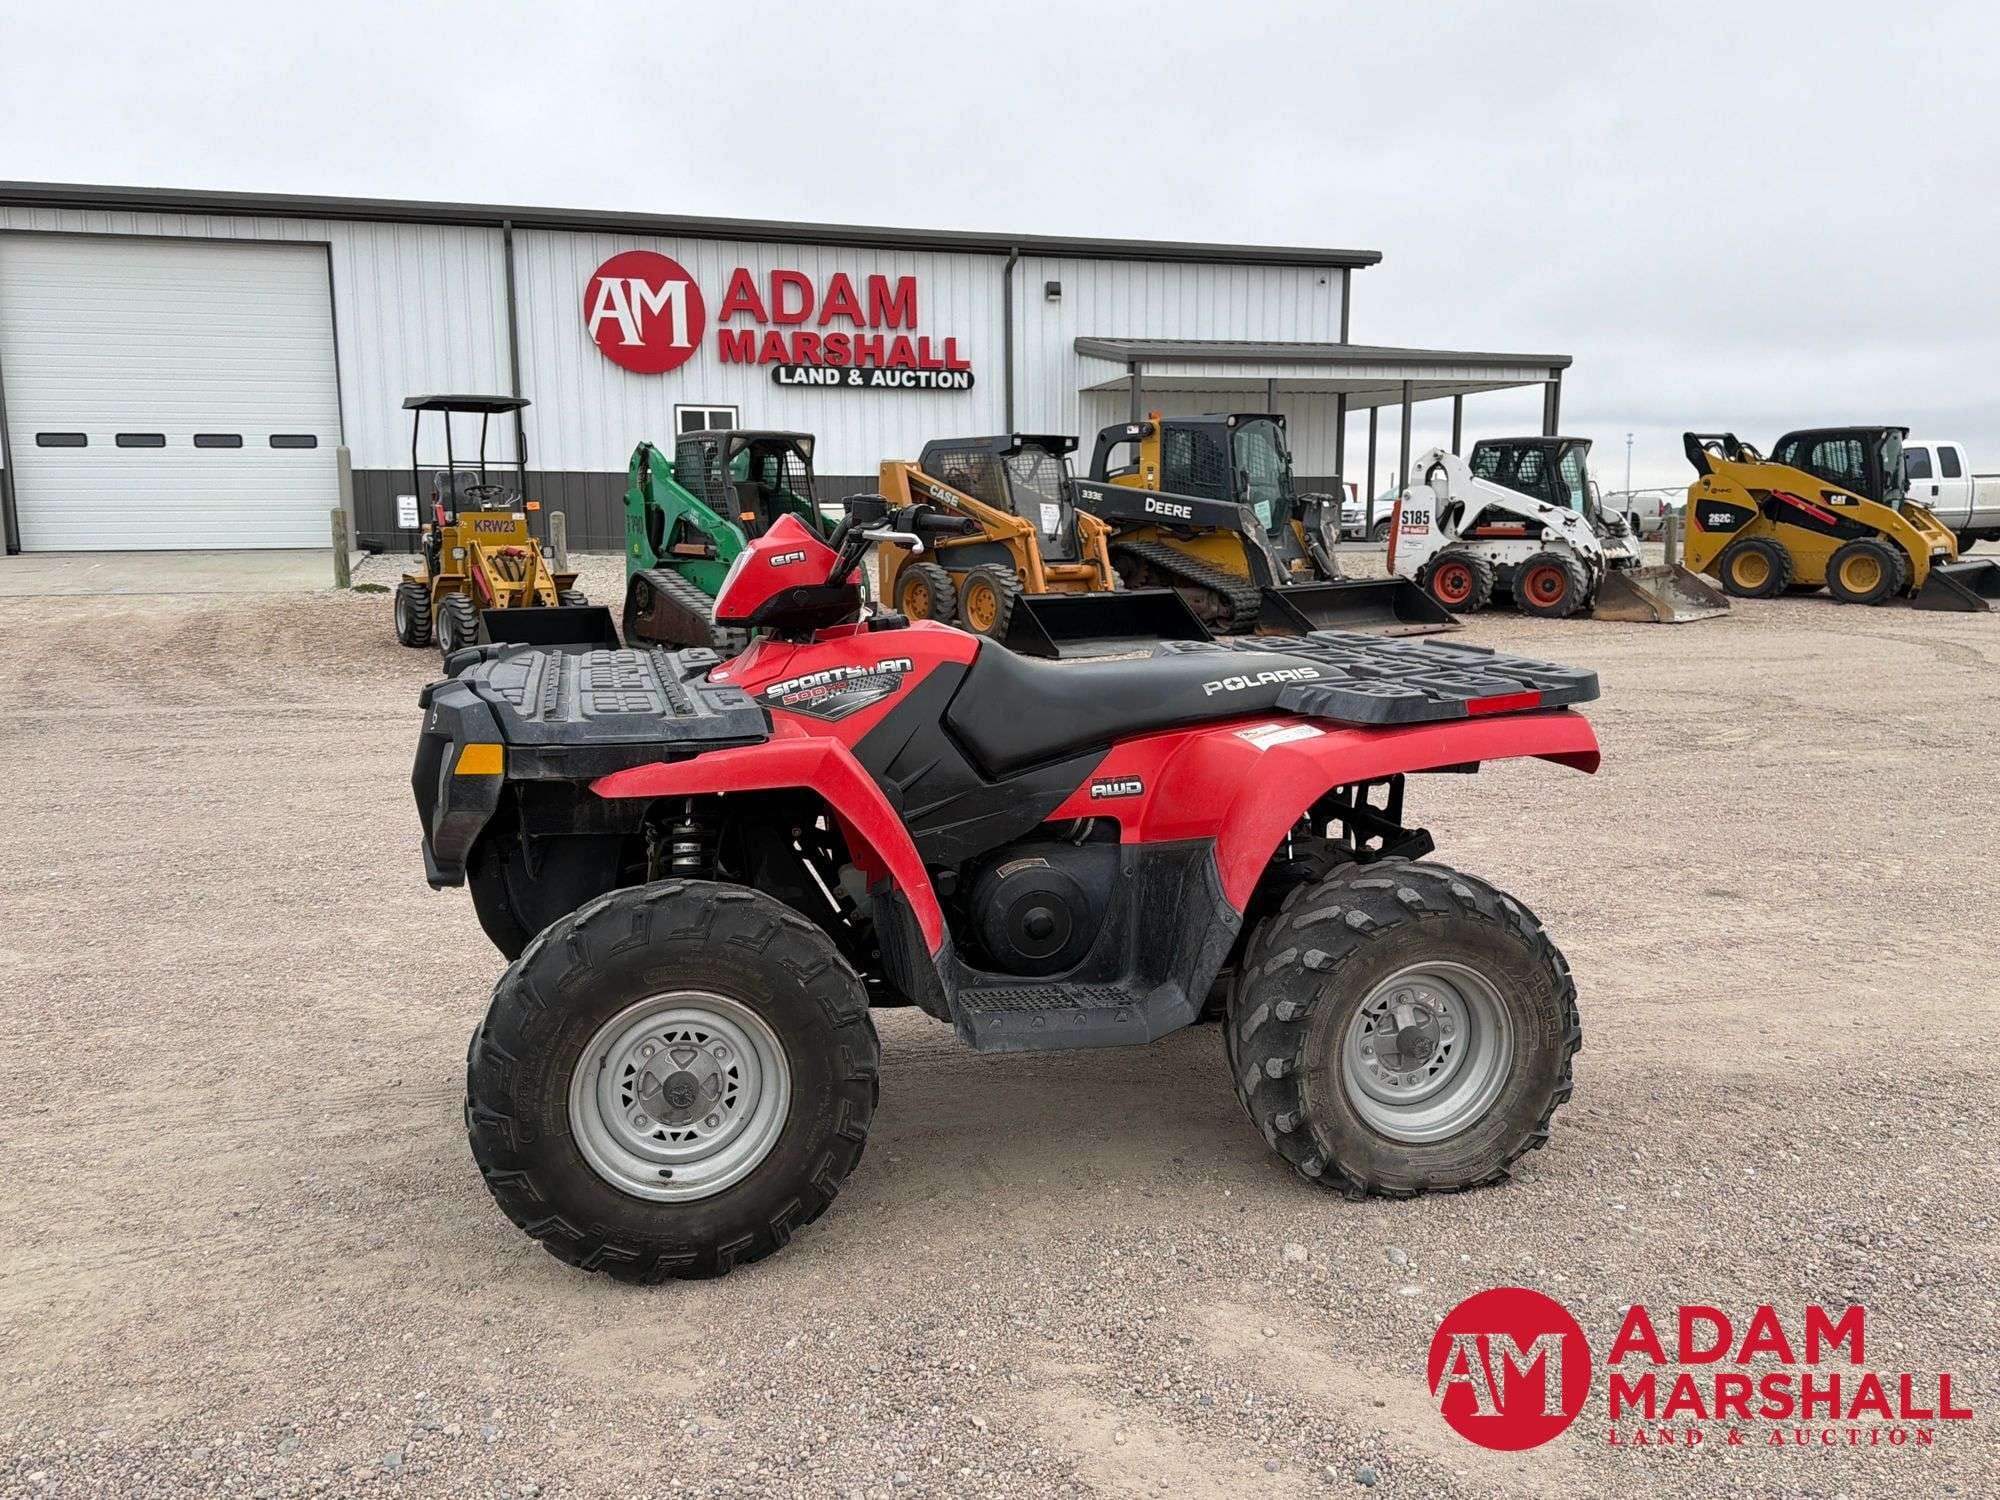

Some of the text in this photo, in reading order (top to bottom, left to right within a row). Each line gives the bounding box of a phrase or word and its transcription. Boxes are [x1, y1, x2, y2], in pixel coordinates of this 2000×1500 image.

[718, 267, 917, 329] ADAM
[588, 276, 694, 348] AM
[718, 328, 971, 370] MARSHALL
[779, 366, 970, 389] LAND & AUCTION
[929, 484, 960, 508] CASE
[1081, 489, 1104, 502] 333E
[1830, 495, 1848, 505] CAT
[1144, 497, 1193, 519] DEERE
[1401, 510, 1430, 525] S185
[473, 519, 517, 533] KRW23
[770, 550, 806, 567] EFI
[766, 658, 912, 699] SPORTSMAN
[1201, 666, 1321, 697] POLARIS
[783, 686, 828, 706] 500
[1091, 781, 1143, 797] AWD
